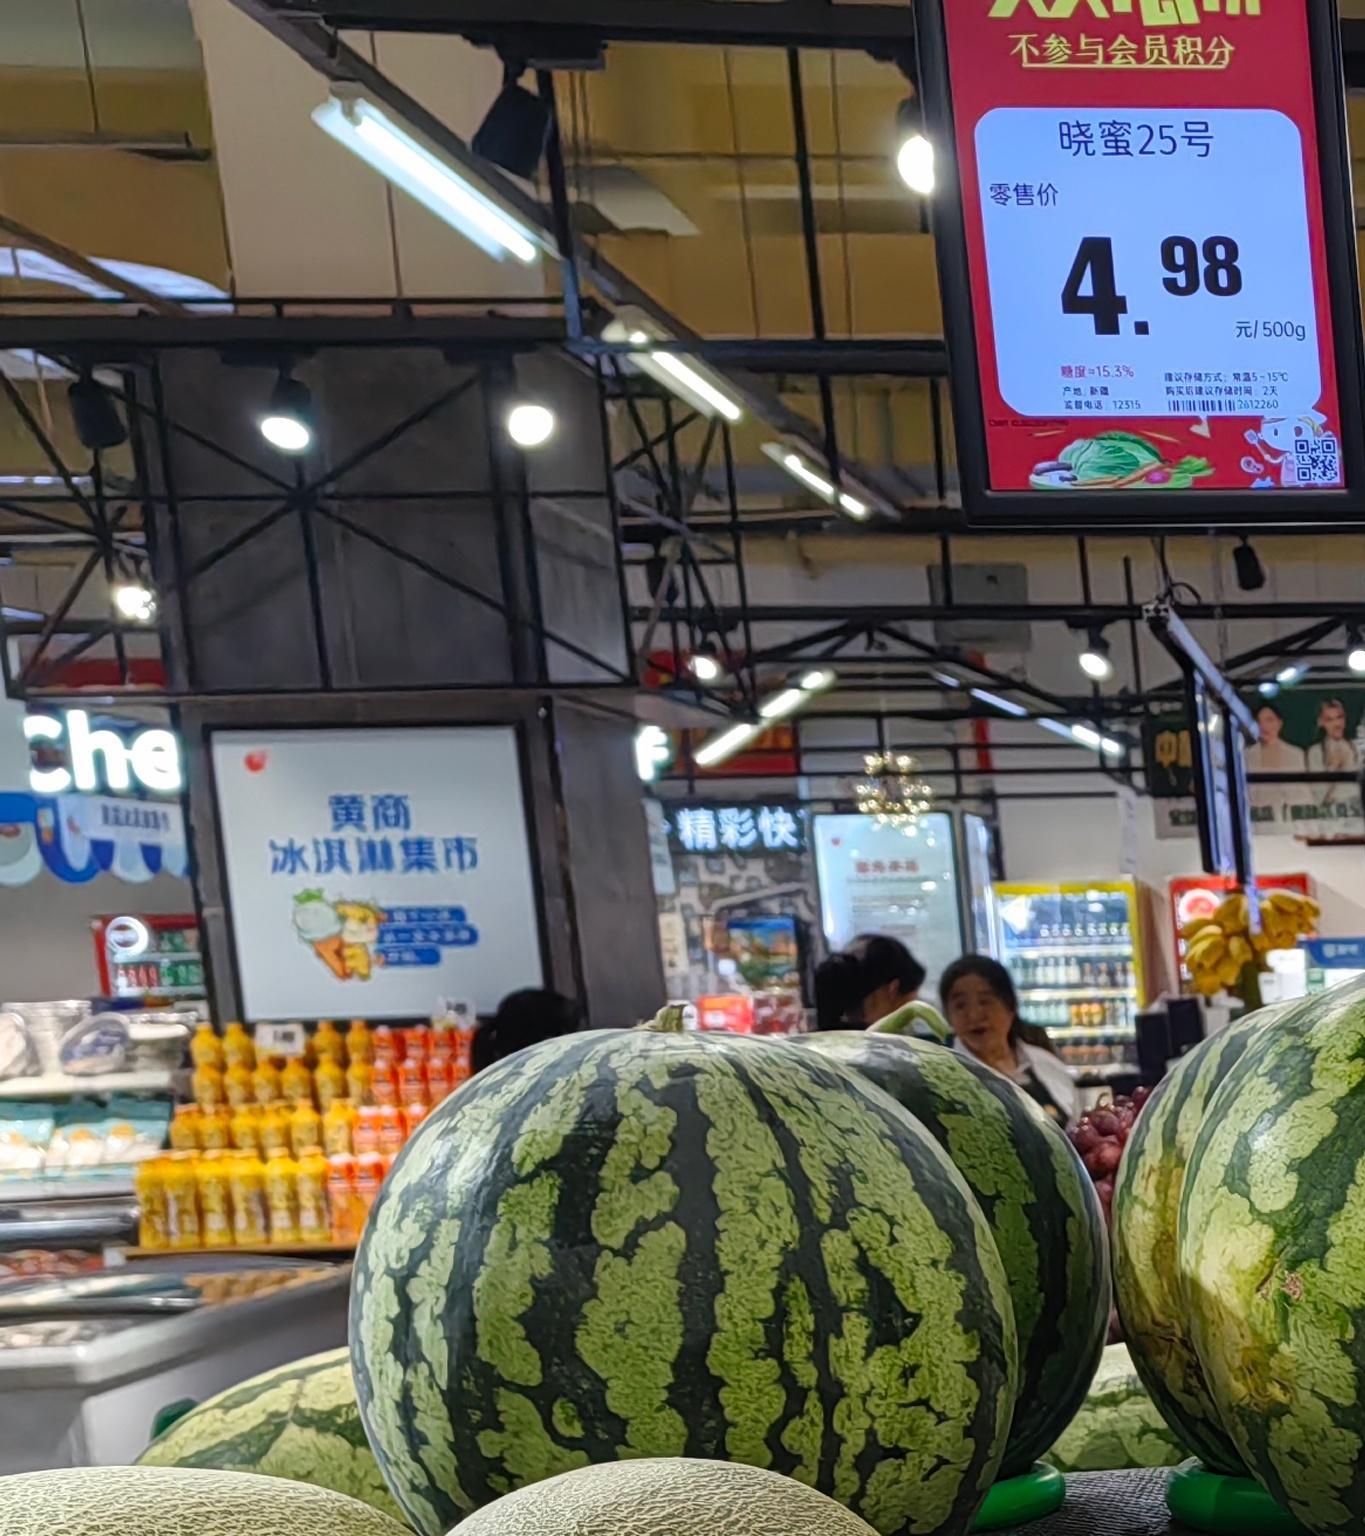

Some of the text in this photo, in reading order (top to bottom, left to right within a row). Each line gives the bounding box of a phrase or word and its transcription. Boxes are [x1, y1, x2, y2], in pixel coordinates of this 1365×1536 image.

[1008, 33, 1236, 67] 不参与会员积分
[1058, 119, 1215, 158] 晓蜜25号
[989, 182, 1059, 208] 零售价
[1235, 320, 1307, 341] 元/500g
[327, 794, 413, 832] 黄商
[268, 836, 481, 875] 冰淇淋集市
